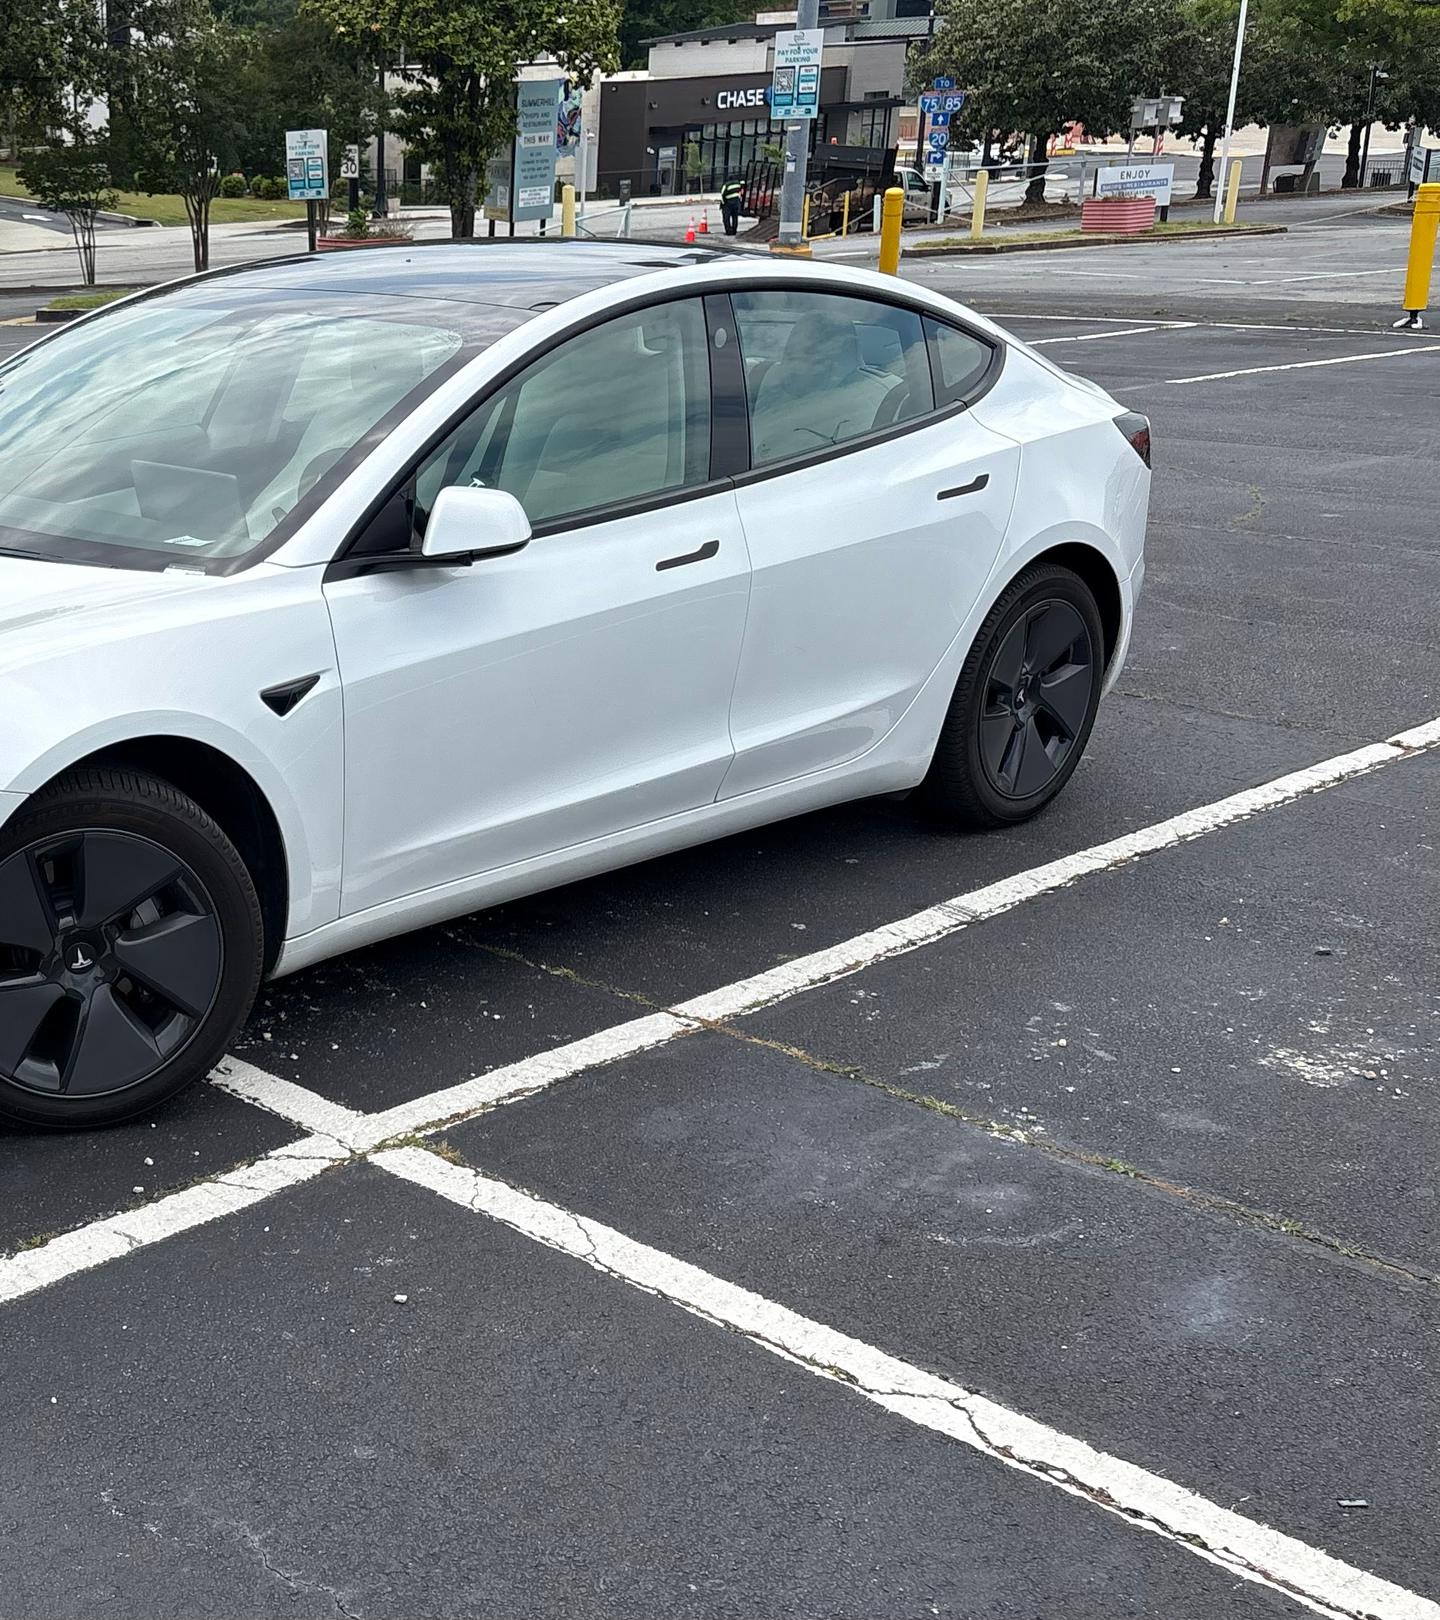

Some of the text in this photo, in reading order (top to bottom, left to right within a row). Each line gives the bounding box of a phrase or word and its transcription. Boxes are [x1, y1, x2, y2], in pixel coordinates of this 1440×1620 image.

[940, 80, 950, 88] TO
[717, 88, 765, 109] CHASE
[924, 98, 938, 111] 75
[945, 97, 961, 111] 85
[524, 135, 550, 144] THIS WAY
[931, 132, 947, 146] 20
[342, 162, 357, 174] 30
[1120, 169, 1151, 180] ENJOY
